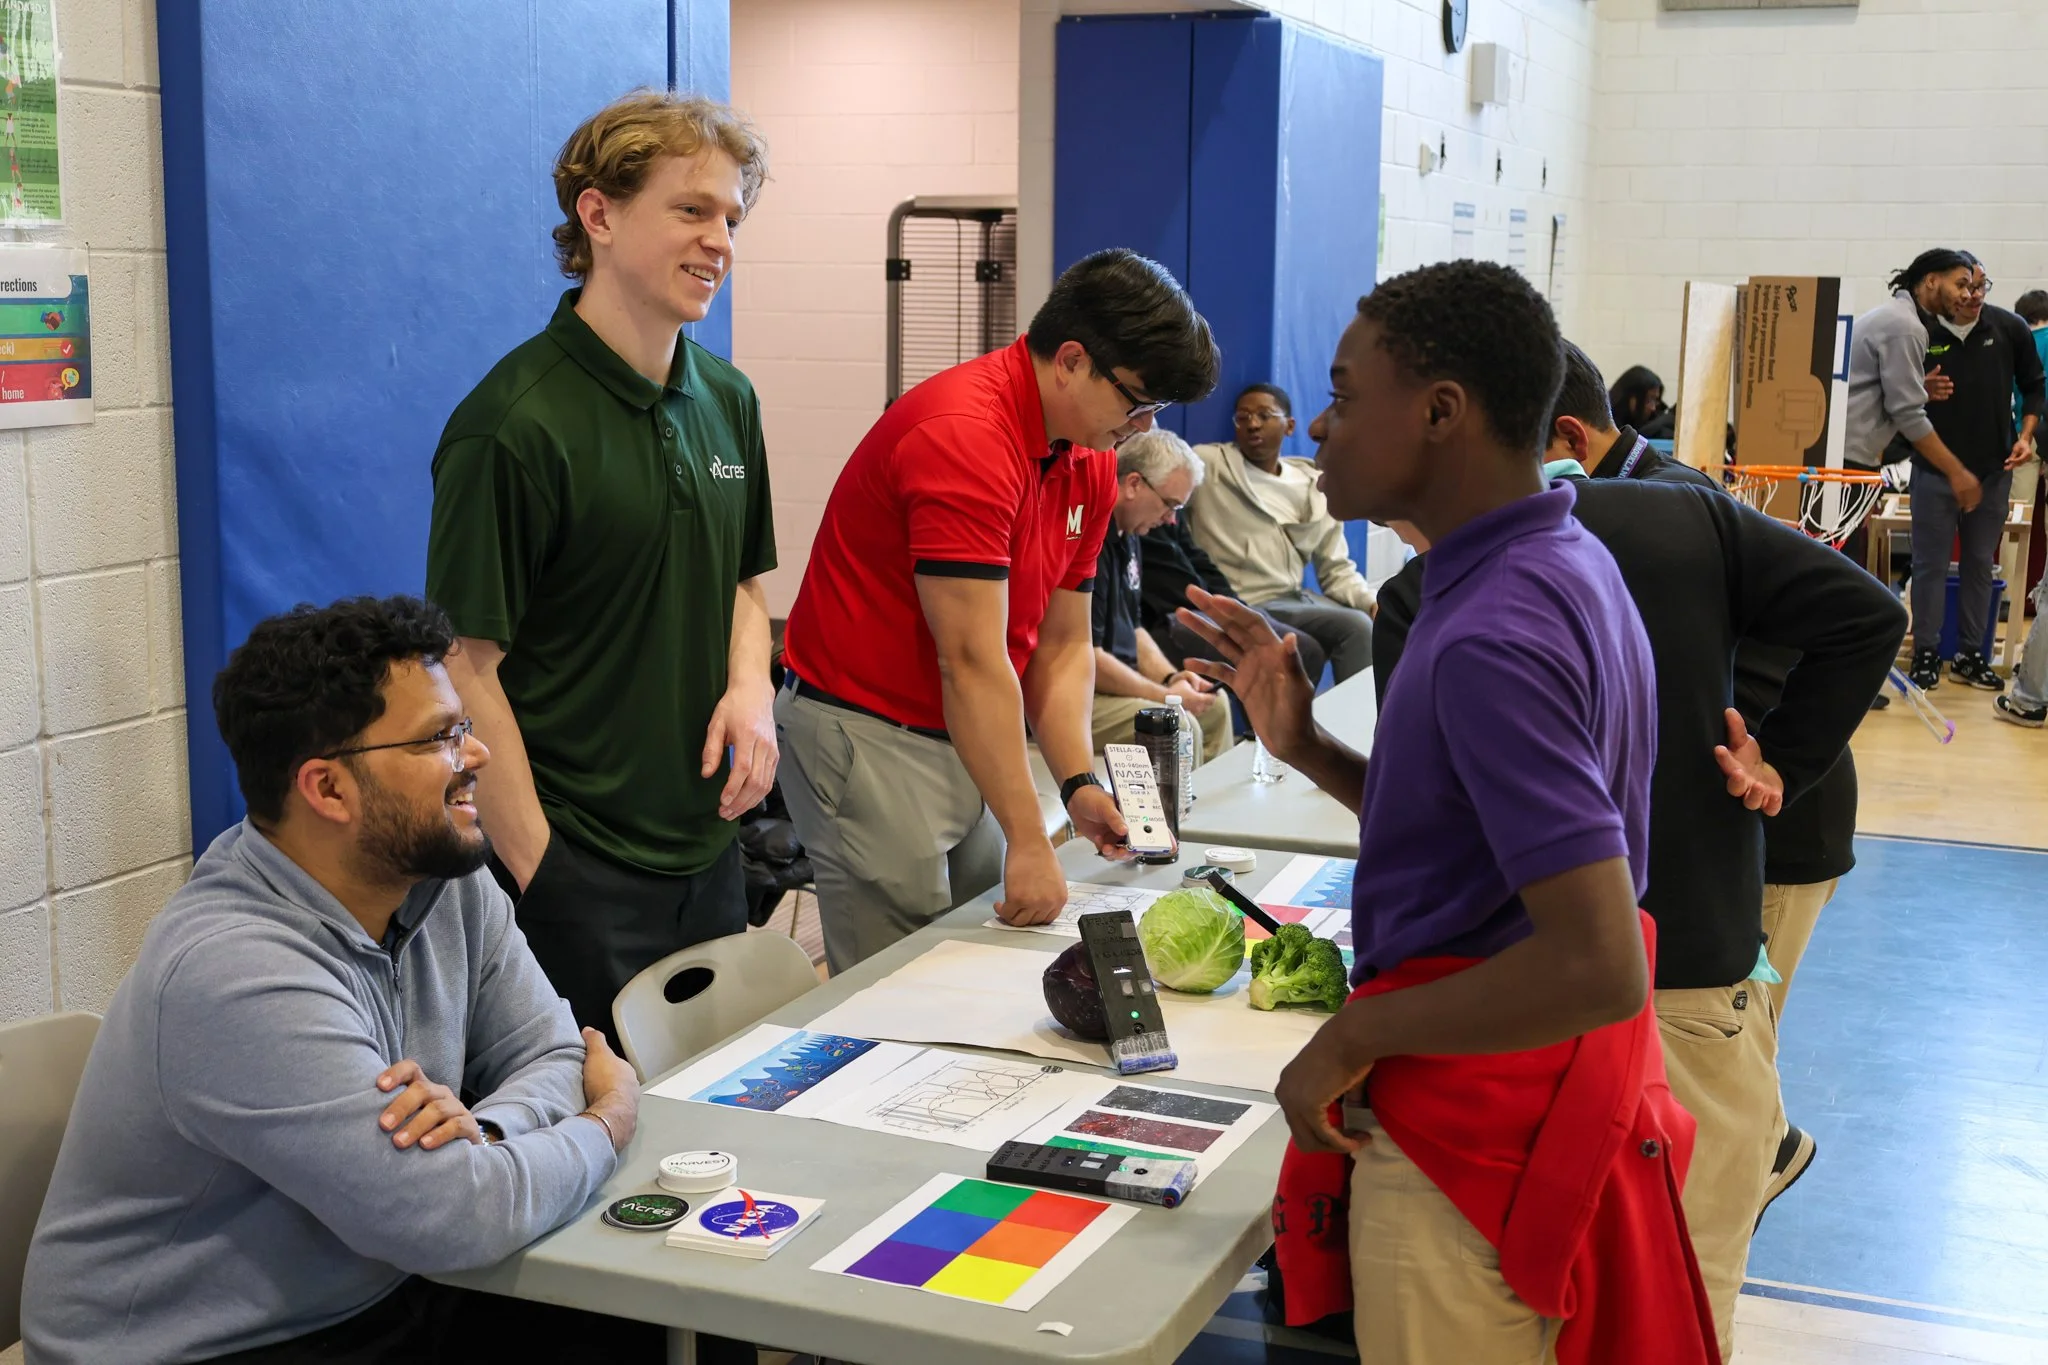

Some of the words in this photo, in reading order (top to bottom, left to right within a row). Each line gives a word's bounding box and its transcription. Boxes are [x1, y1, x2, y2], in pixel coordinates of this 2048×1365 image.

[2, 387, 24, 400] home
[709, 455, 745, 479] Acres
[1066, 505, 1084, 536] M
[1109, 746, 1146, 754] STELLA-Q2
[1115, 770, 1152, 779] NASA
[621, 1202, 675, 1217] Acres
[722, 1204, 777, 1235] NASA
